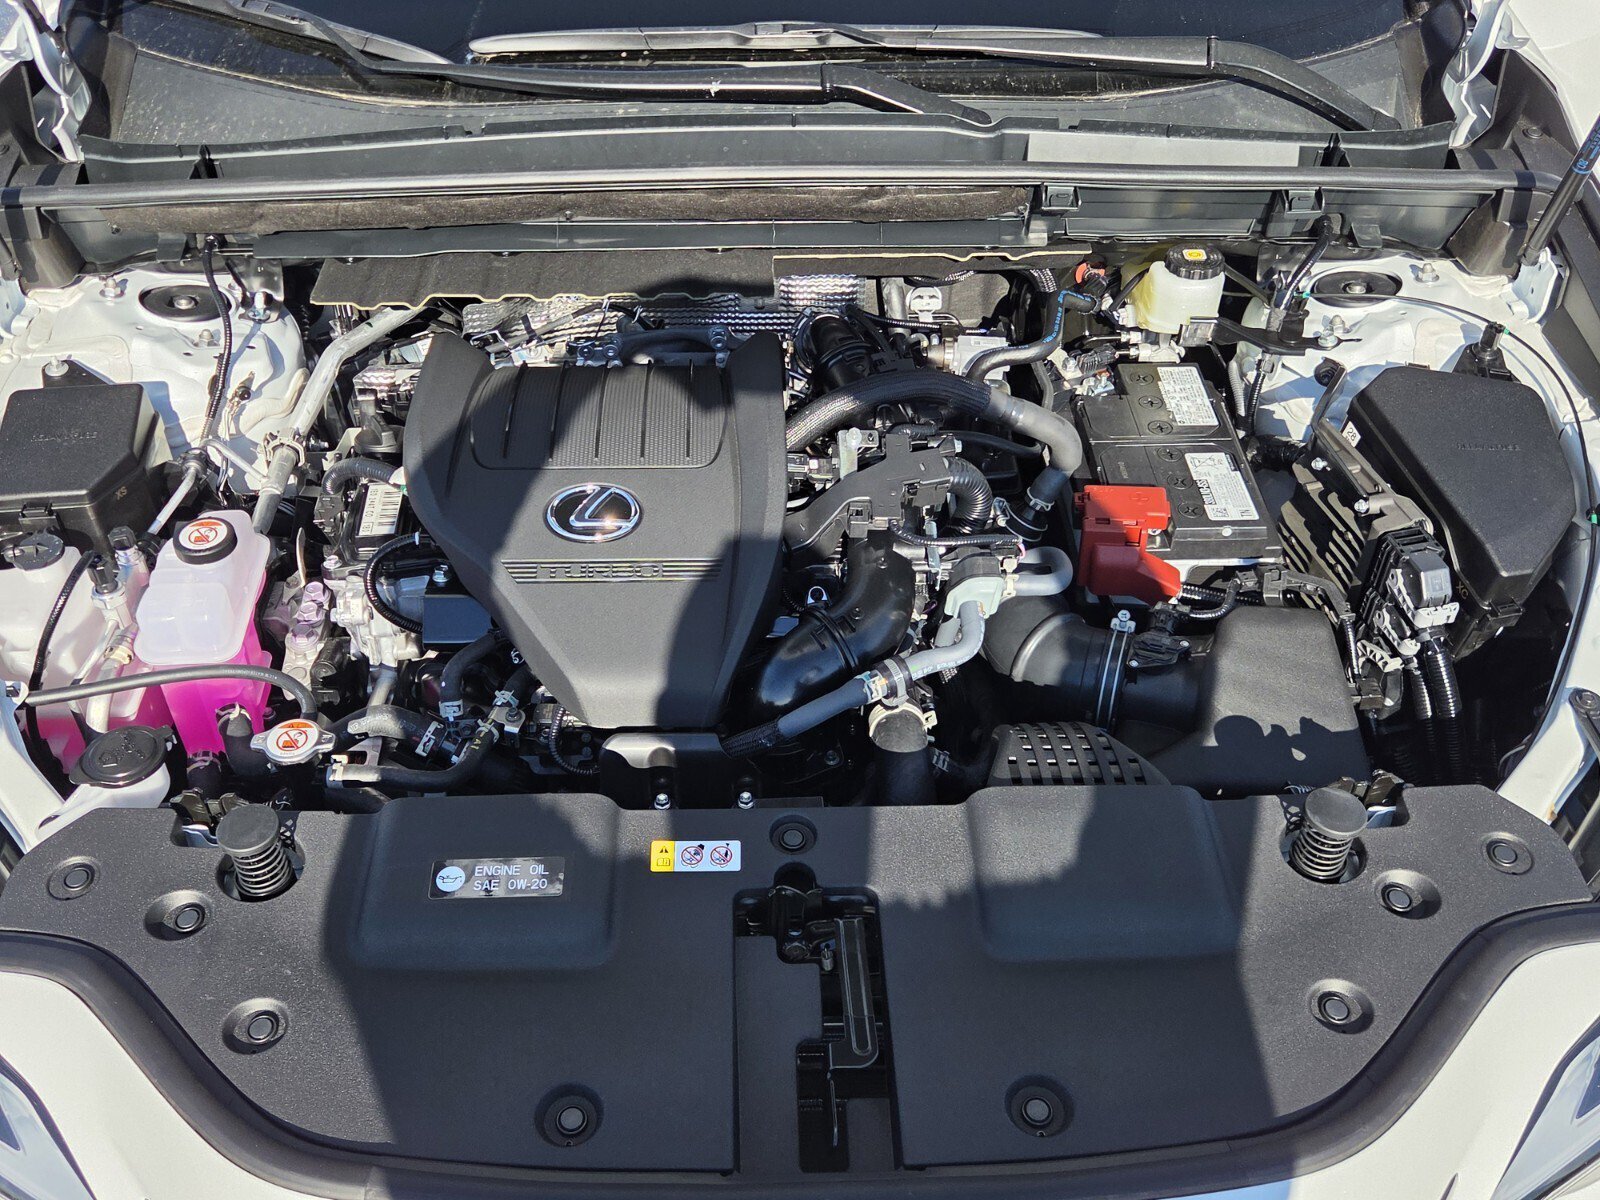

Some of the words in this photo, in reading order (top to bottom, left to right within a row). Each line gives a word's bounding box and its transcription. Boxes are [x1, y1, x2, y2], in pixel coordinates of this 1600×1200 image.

[1347, 428, 1357, 441] 28
[540, 563, 660, 578] TURBO
[474, 864, 521, 877] ENGINE
[529, 864, 549, 875] OIL
[473, 879, 500, 891] SAE
[508, 878, 548, 890] 0W-20
